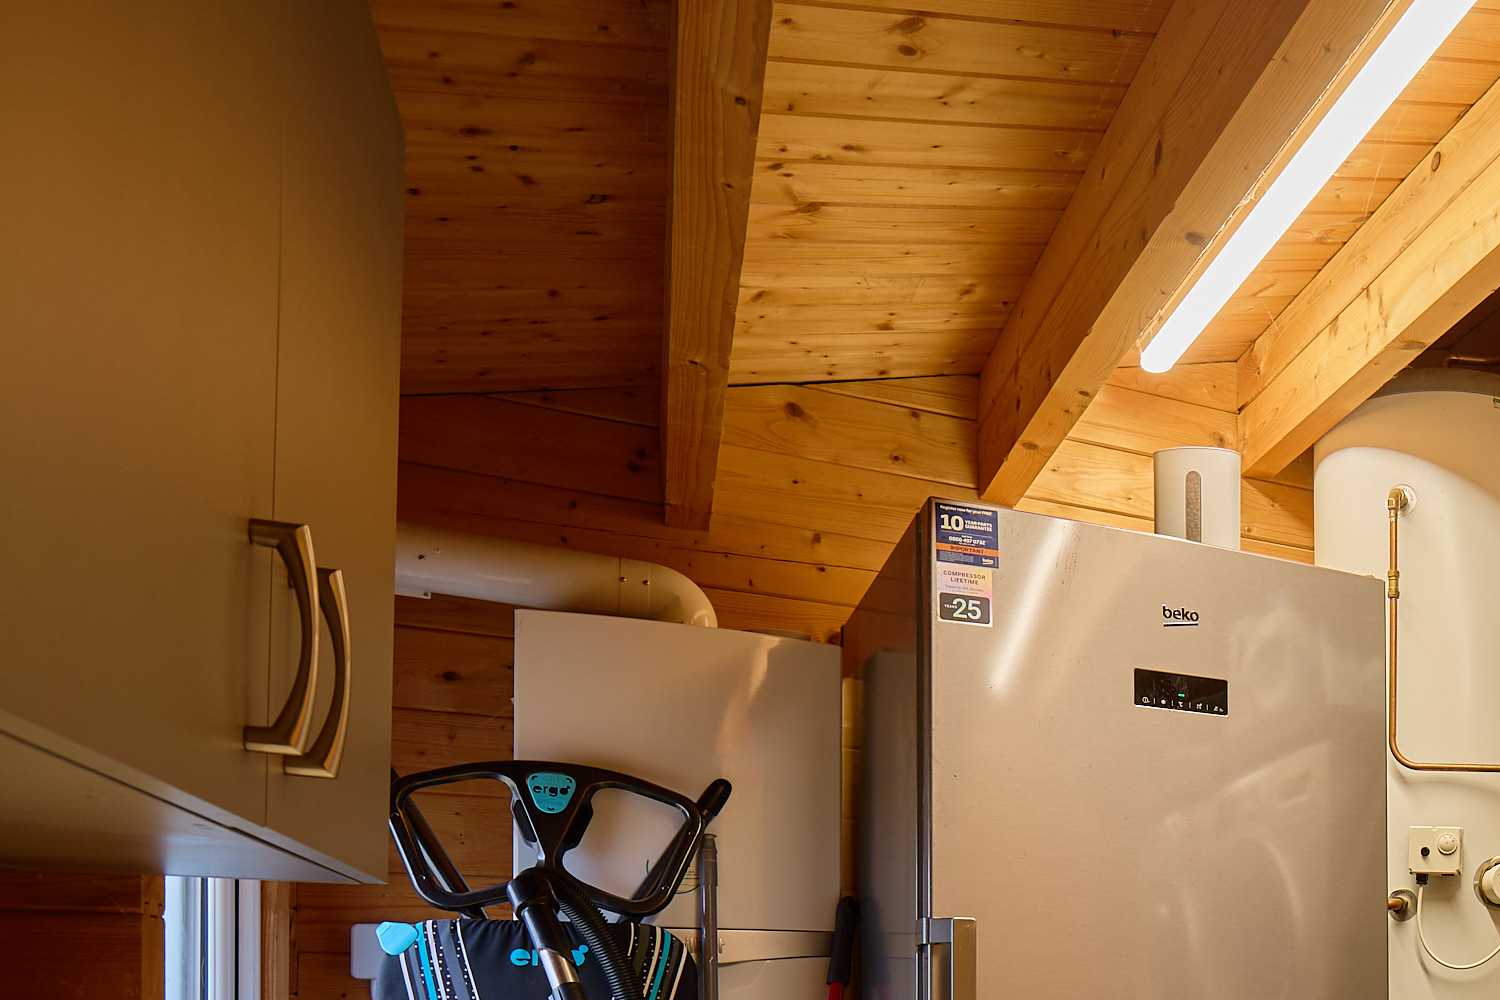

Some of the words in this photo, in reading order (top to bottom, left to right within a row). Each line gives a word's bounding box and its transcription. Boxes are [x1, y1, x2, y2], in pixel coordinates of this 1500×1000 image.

[940, 514, 964, 532] 10
[950, 546, 984, 554] IMPORTANT
[943, 570, 986, 580] COMPRESSOR
[951, 577, 979, 585] LIFETIME
[952, 598, 982, 620] 25
[1162, 604, 1199, 622] beko
[533, 785, 571, 797] ergo
